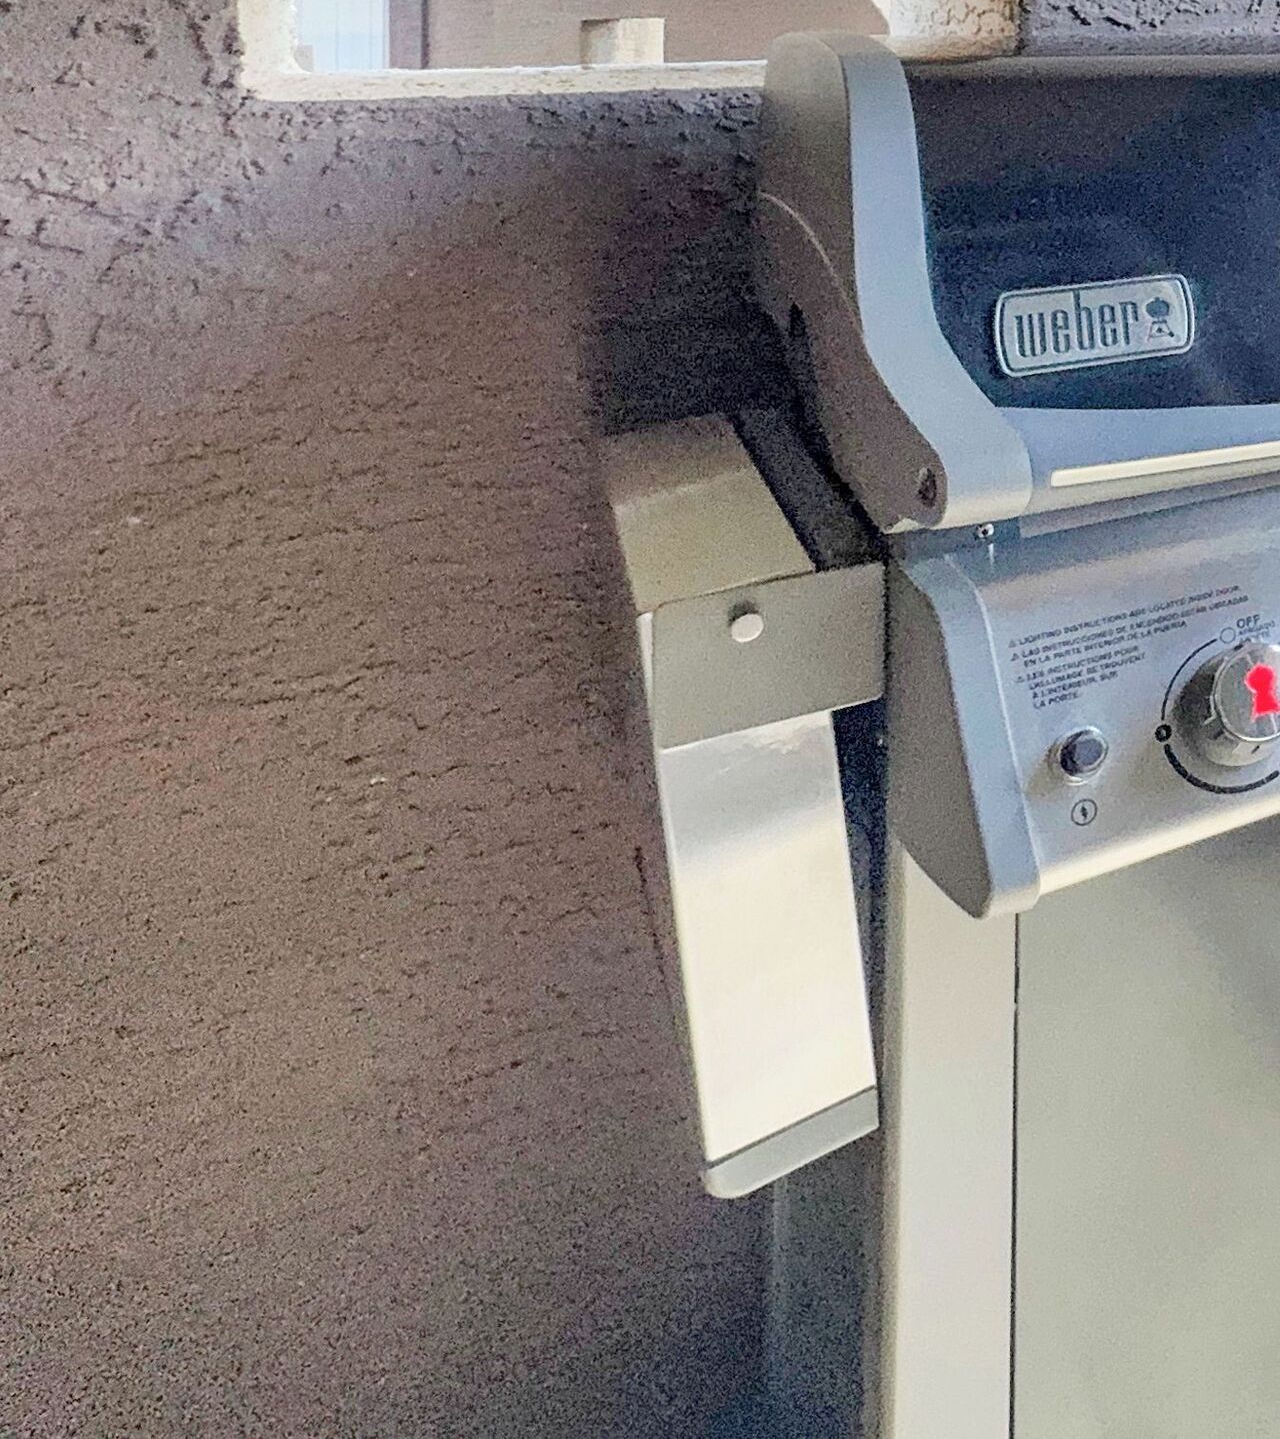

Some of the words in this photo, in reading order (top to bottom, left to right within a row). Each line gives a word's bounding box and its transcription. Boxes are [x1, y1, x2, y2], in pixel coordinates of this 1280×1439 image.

[1015, 289, 1139, 358] weber
[1063, 612, 1127, 634] INSTRUCTIONS
[1236, 614, 1260, 629] OFF
